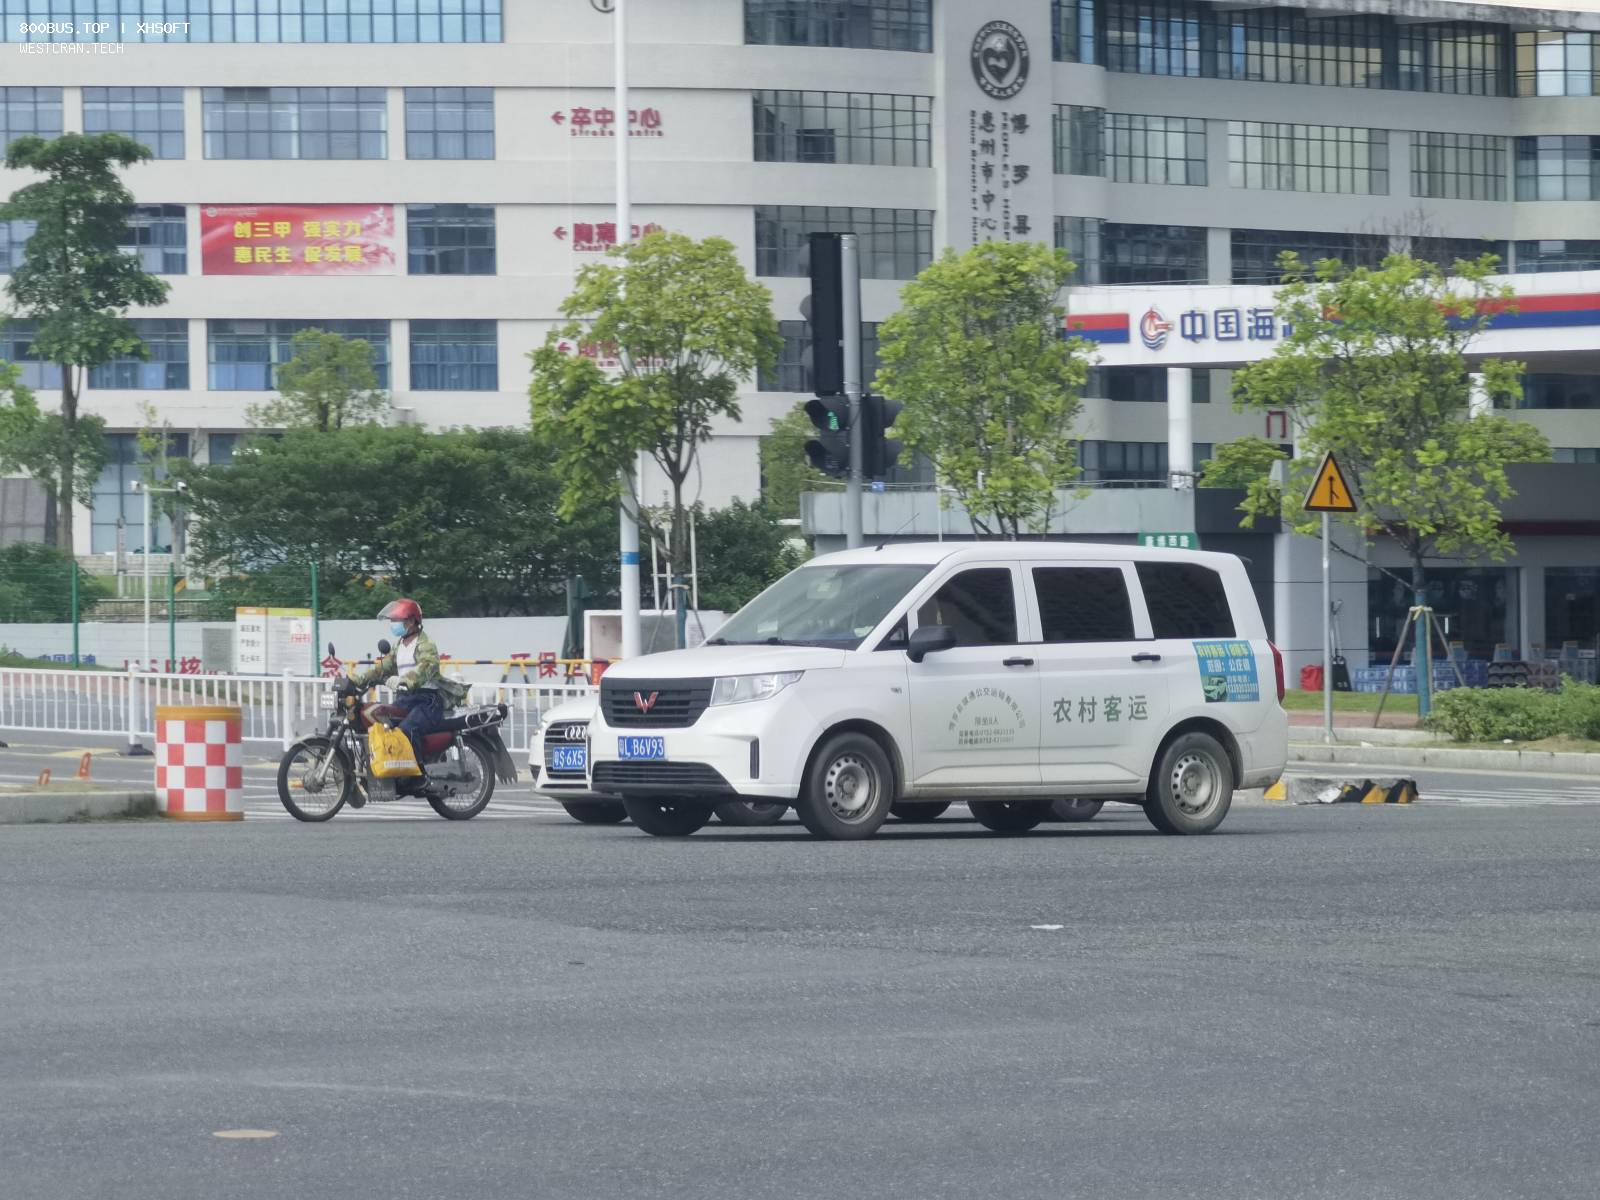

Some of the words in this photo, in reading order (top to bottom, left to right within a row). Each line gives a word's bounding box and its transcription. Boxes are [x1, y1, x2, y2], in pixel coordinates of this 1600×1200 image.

[978, 110, 997, 240] 惠州市中心
[233, 220, 292, 238] 创三甲
[303, 220, 362, 238] 强实力
[233, 245, 292, 263] 惠民生
[304, 245, 363, 263] 促发展
[1053, 695, 1148, 723] 农村客运
